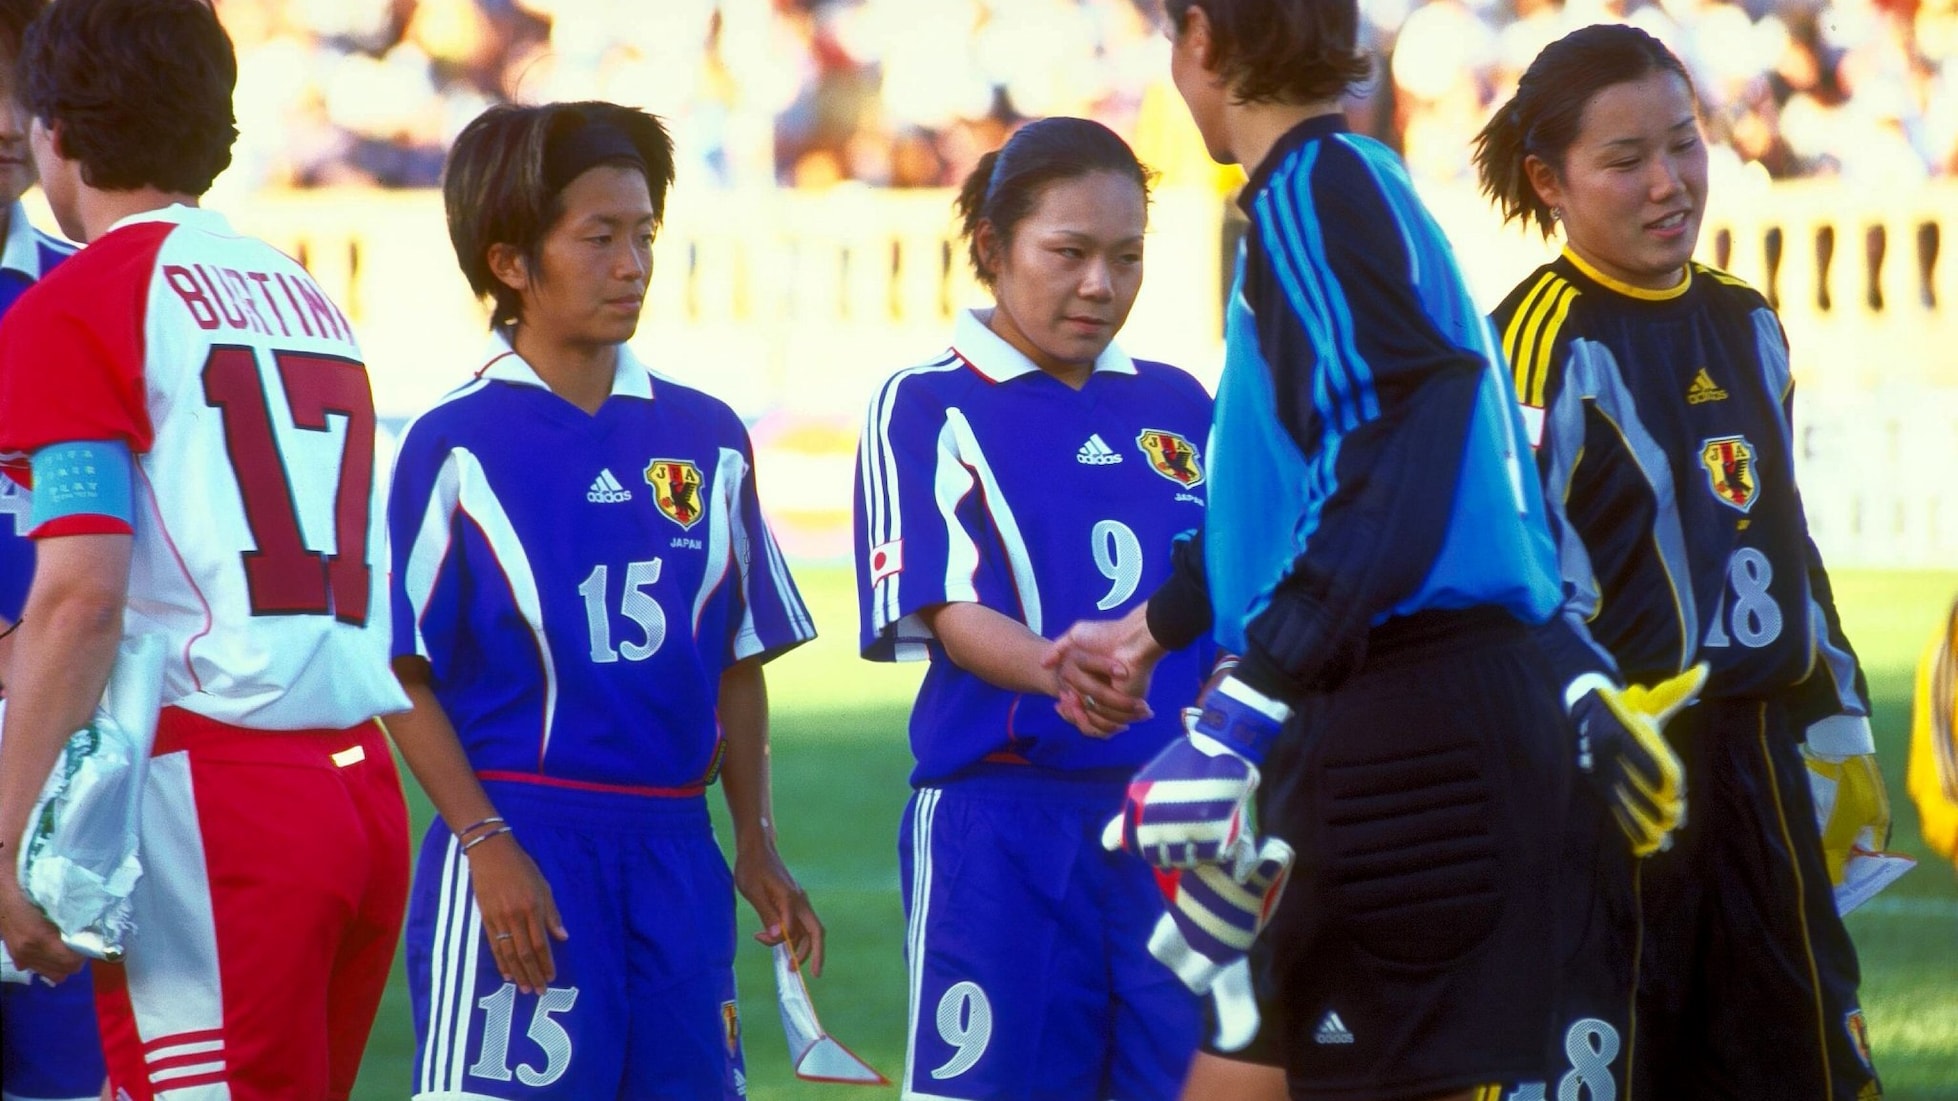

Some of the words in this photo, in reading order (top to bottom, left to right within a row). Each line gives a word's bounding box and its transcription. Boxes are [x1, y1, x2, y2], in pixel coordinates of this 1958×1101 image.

[1076, 453, 1123, 465] adidas
[1149, 436, 1190, 452] JA
[1710, 444, 1748, 462] JA
[201, 343, 376, 628] 17
[586, 490, 632, 503] adidas
[669, 537, 702, 550] JAPAN
[1091, 519, 1143, 611] 9
[578, 556, 666, 663] 15
[469, 982, 579, 1087] 15
[930, 980, 993, 1080] 9
[1315, 1032, 1354, 1044] adidas
[1508, 1018, 1620, 1101] 8
